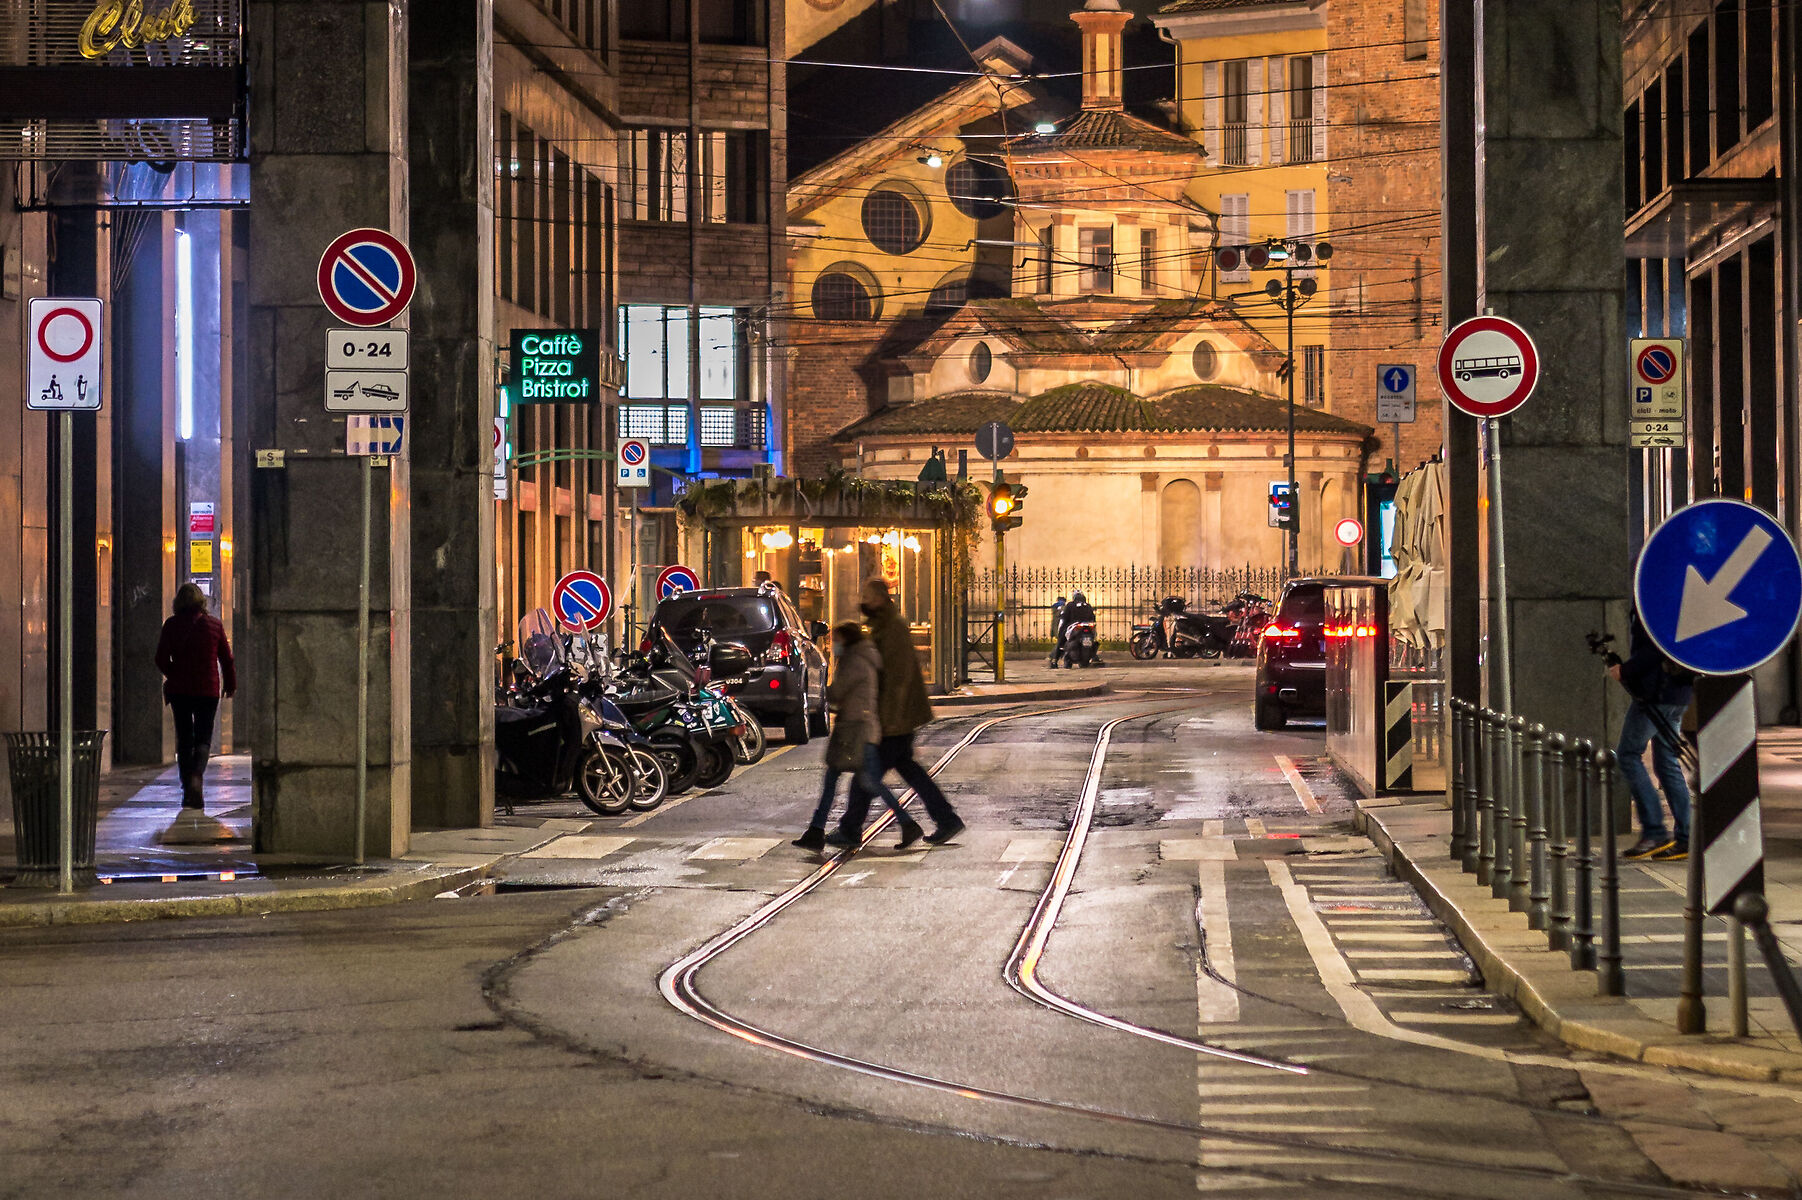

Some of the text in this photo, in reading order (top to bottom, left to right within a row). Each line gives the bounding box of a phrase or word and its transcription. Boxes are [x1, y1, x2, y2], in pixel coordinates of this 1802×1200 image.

[521, 334, 582, 355] Caffè
[521, 357, 573, 376] Pizza
[522, 377, 589, 398] Bristrot
[1640, 389, 1649, 401] P
[1645, 424, 1669, 432] 0-24
